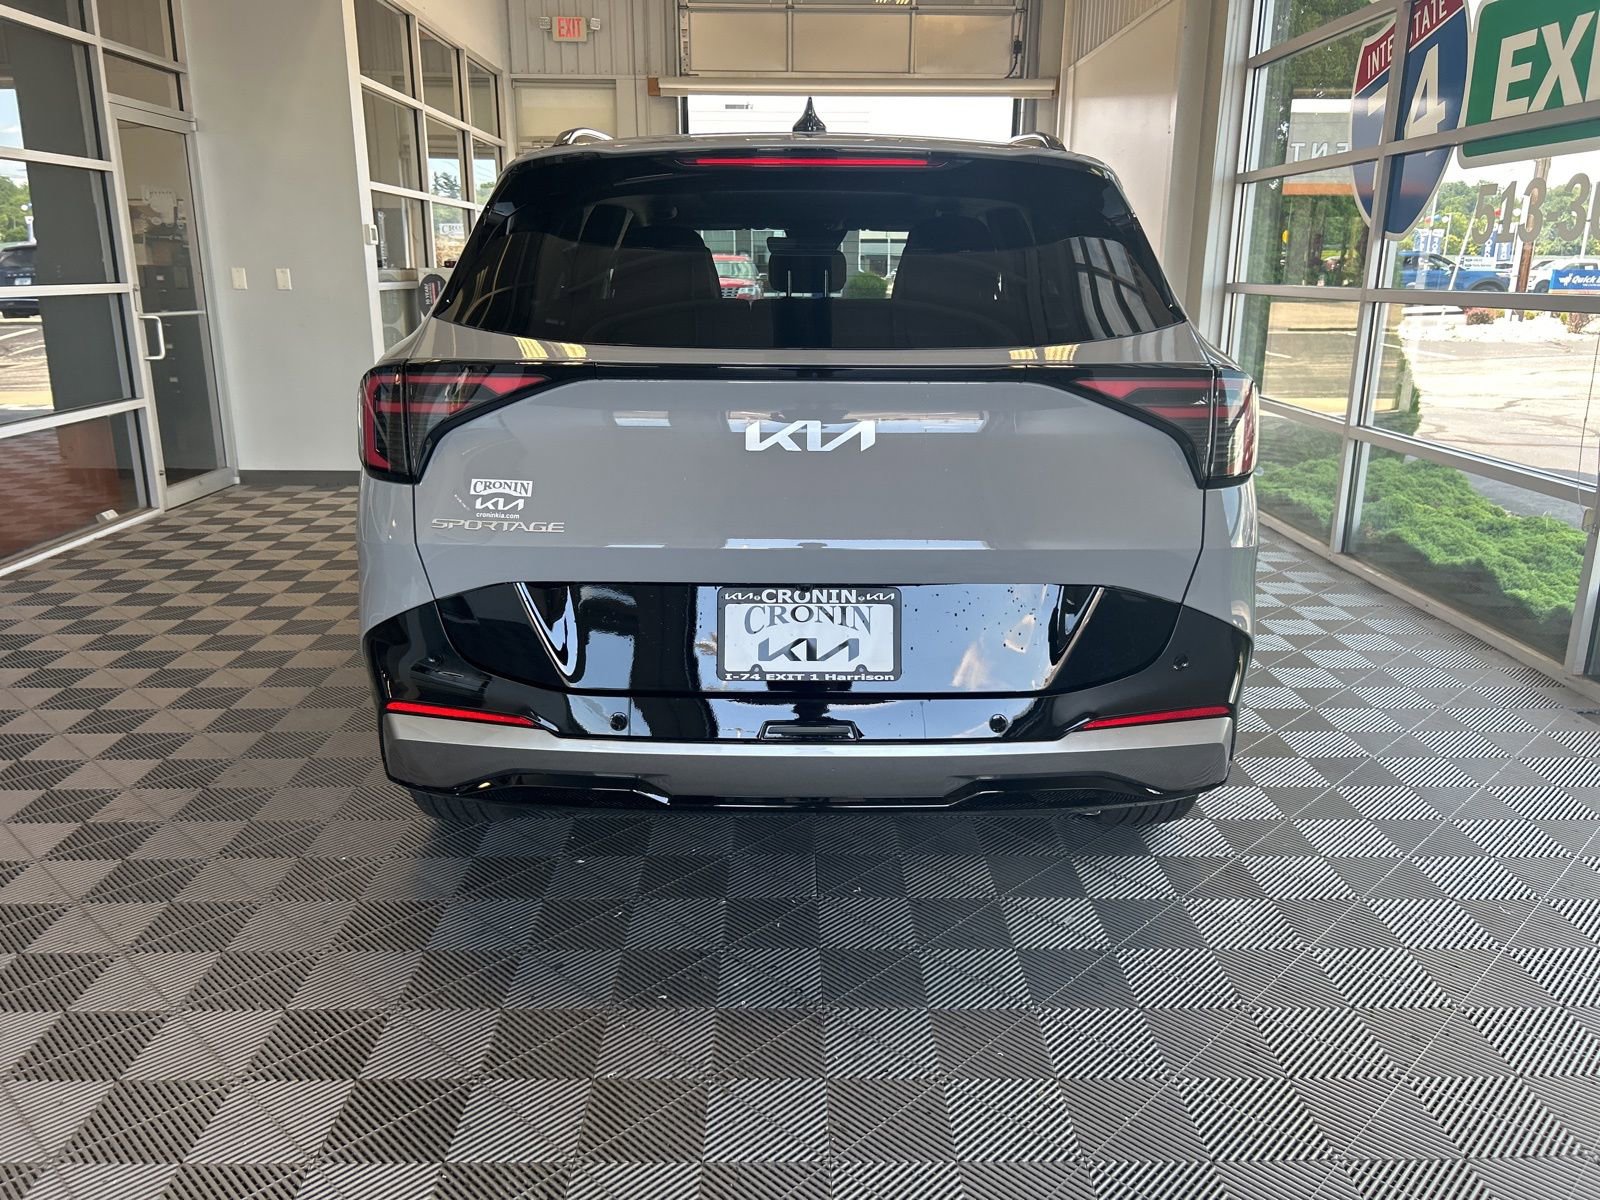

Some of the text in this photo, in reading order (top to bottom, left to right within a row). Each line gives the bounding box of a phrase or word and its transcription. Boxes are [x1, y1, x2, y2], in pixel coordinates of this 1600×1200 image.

[557, 16, 582, 38] EXIT
[1471, 172, 1600, 245] 513-3
[1572, 274, 1596, 285] Quick
[745, 420, 875, 451] KIA
[472, 480, 530, 496] CRONIN
[475, 497, 525, 511] KIA
[431, 518, 565, 533] SPORTAGE
[725, 589, 895, 604] KIA CRONIN KIA
[743, 605, 874, 635] CRONIN
[757, 637, 860, 662] KIA
[725, 673, 895, 681] I-74 EXIT 1 Harrison
